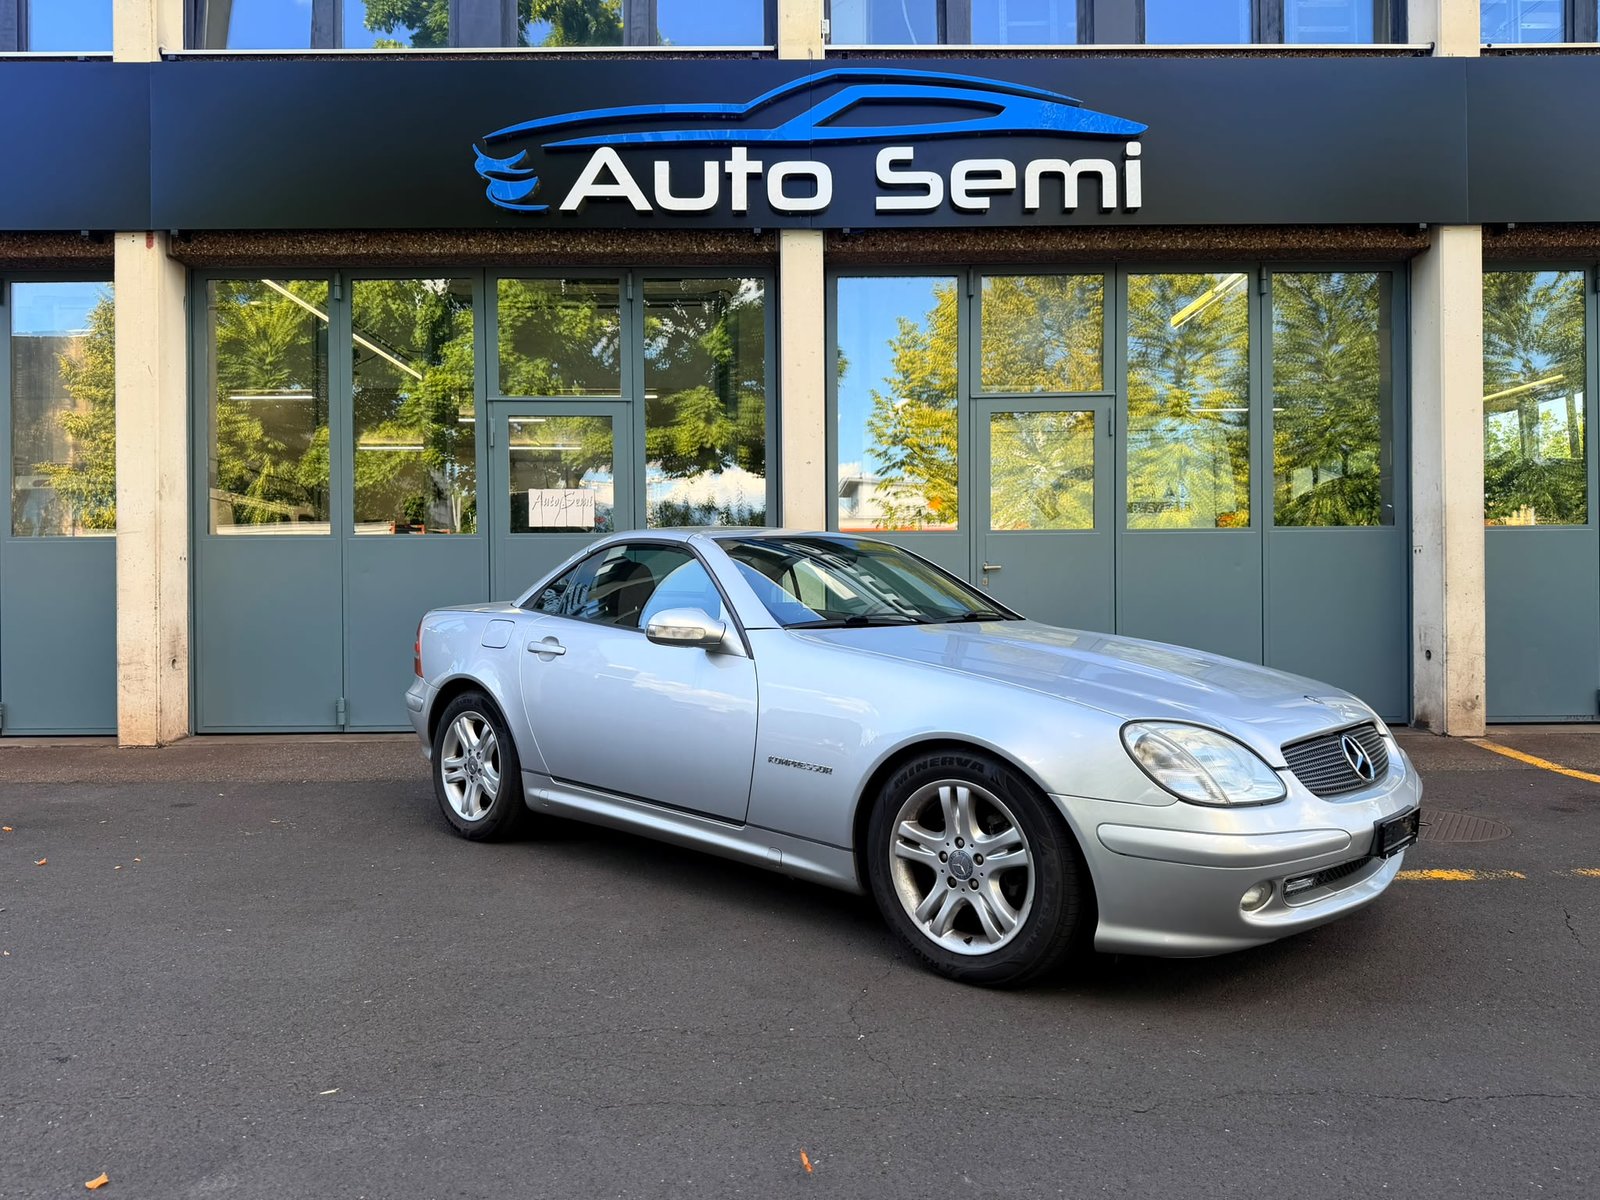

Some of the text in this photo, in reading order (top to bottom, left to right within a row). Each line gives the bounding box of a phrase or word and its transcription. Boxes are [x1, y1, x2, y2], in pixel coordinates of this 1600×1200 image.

[559, 141, 1142, 211] Auto Semi
[768, 755, 833, 775] KOMPRESSOR
[893, 756, 986, 790] MINERVA
